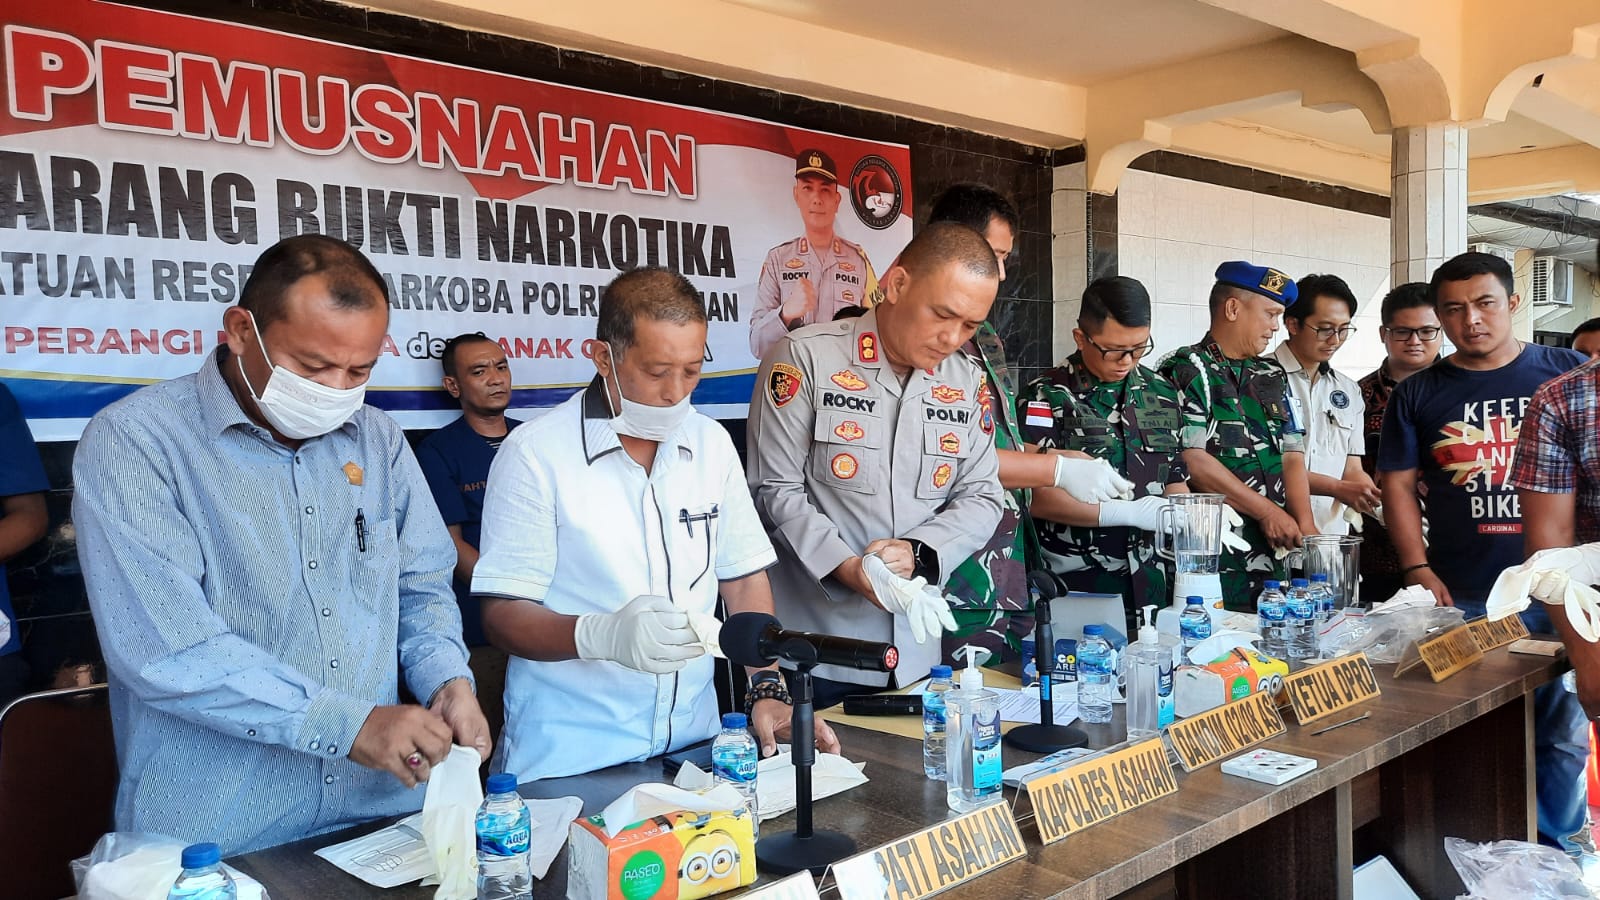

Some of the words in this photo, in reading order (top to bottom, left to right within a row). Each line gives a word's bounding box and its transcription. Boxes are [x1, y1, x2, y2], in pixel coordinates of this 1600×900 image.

[4, 25, 698, 200] PEMUSNAHAN
[277, 179, 462, 260] BUKTI
[475, 198, 737, 279] NARKOTIKA
[0, 250, 136, 300] TUAN
[782, 271, 810, 281] ROCKY
[835, 273, 860, 285] POLRI
[5, 326, 203, 356] PERANGI
[498, 336, 574, 360] ANAK
[822, 392, 876, 414] ROCKY
[926, 406, 970, 425] POLRI
[1463, 397, 1532, 422] KEEP
[1462, 420, 1523, 446] CAL
[1465, 469, 1516, 493] STA
[1470, 494, 1523, 519] BIKE
[1481, 524, 1518, 533] CARDINAL
[1286, 669, 1341, 721] KETUA
[1336, 659, 1377, 703] DPRD
[1174, 711, 1235, 767] DANDIM
[738, 760, 757, 773] AQUA
[1031, 765, 1119, 841] KAPOLRES
[1111, 746, 1175, 810] ASAHAN
[506, 829, 528, 846] AQUA
[927, 804, 1022, 886] ASAHAN
[624, 863, 661, 883] PASEO
